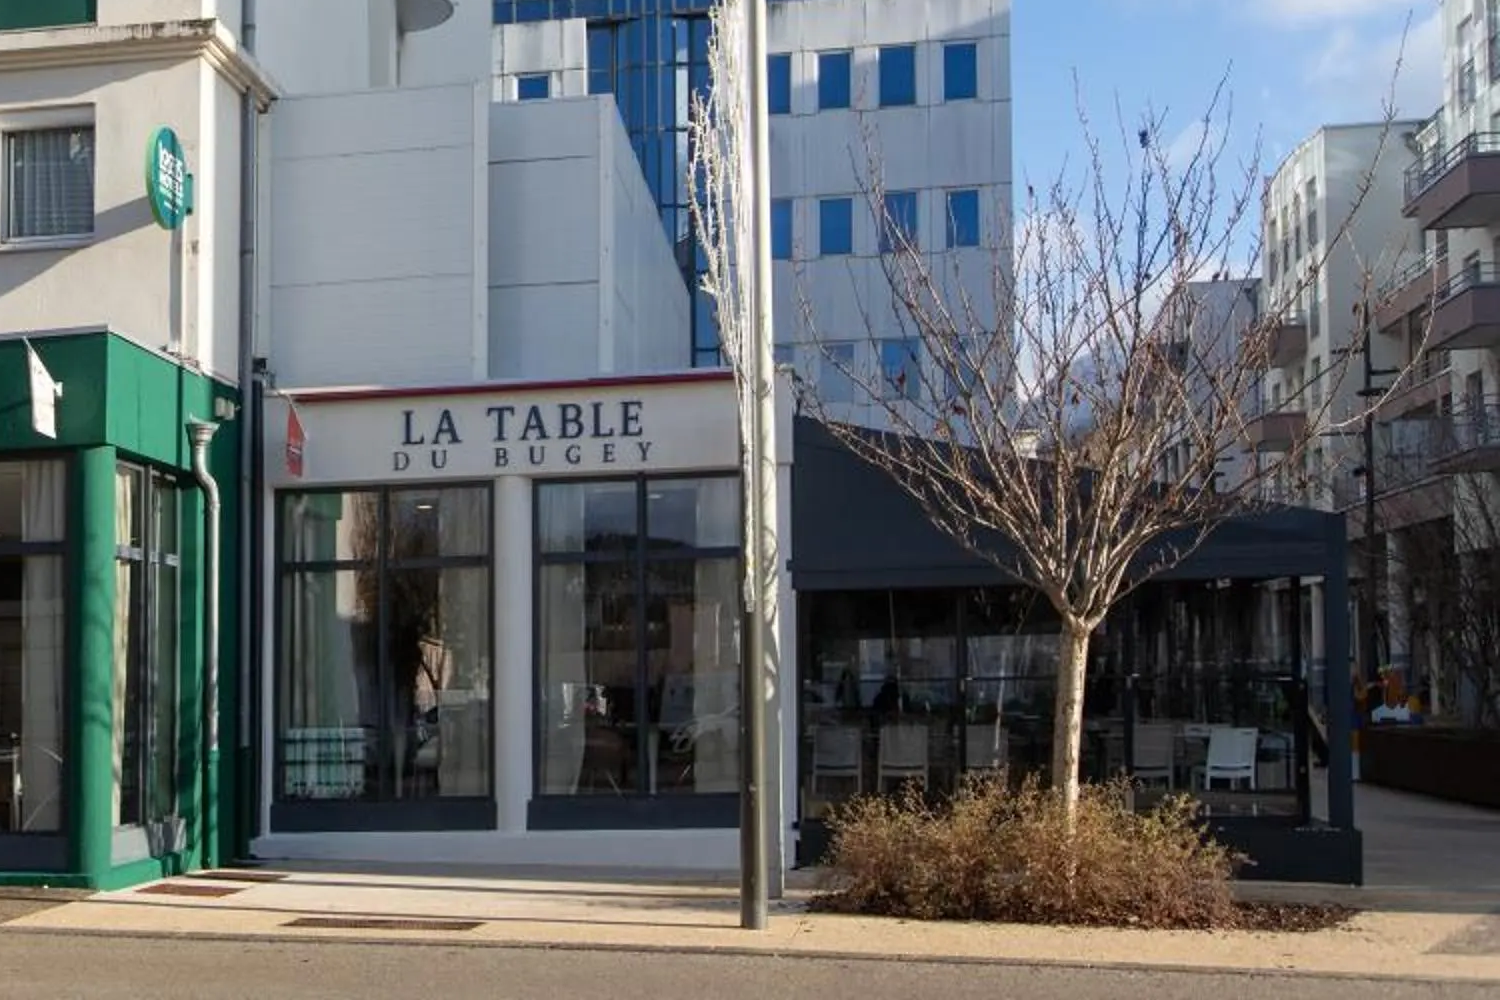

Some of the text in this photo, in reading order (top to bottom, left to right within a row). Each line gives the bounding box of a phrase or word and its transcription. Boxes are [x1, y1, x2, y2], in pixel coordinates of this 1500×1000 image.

[401, 401, 645, 446] LA TABLE
[392, 441, 653, 473] DU BUGEY
